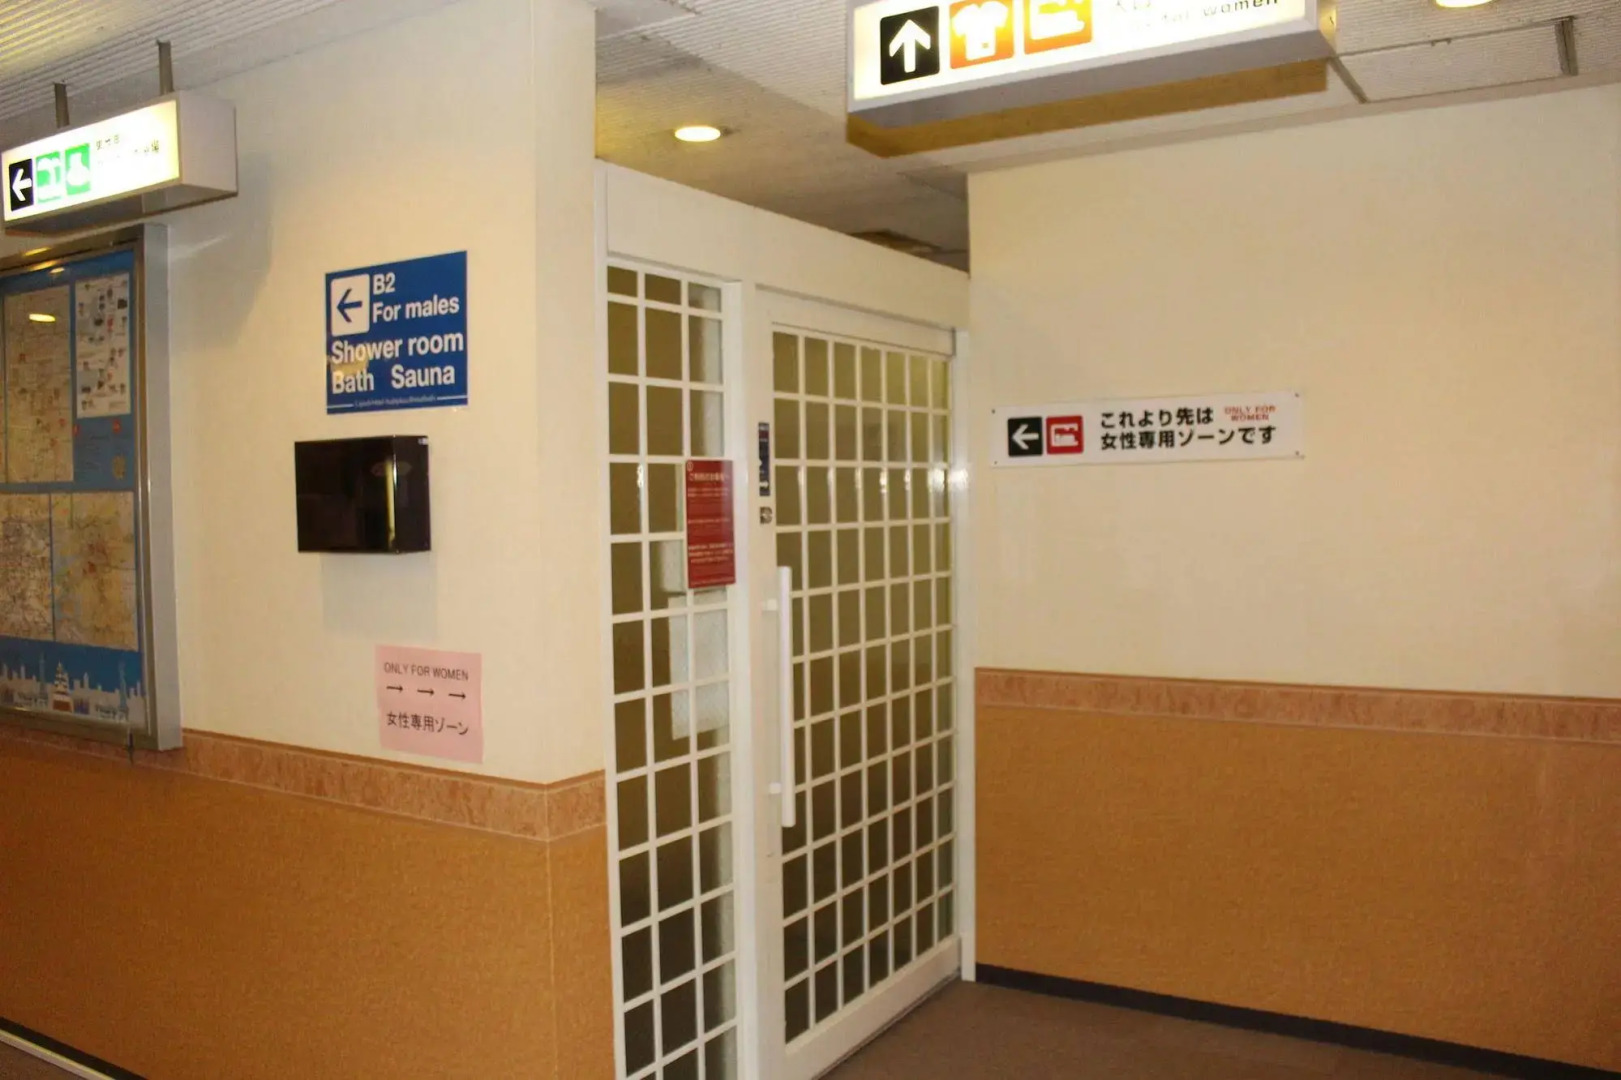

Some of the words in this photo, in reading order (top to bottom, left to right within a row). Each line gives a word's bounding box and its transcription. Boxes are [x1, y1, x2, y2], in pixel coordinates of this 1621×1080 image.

[372, 272, 396, 296] B2
[372, 301, 401, 323] For
[405, 294, 459, 319] males
[331, 339, 403, 365] Shower
[408, 332, 464, 357] room
[332, 370, 375, 393] Bath
[391, 364, 456, 389] Sauna
[1101, 407, 1213, 428] これより先は
[1231, 413, 1269, 421] WOMEN
[384, 662, 409, 674] ONLY
[411, 664, 430, 676] FOR
[432, 667, 469, 680] WOMEN
